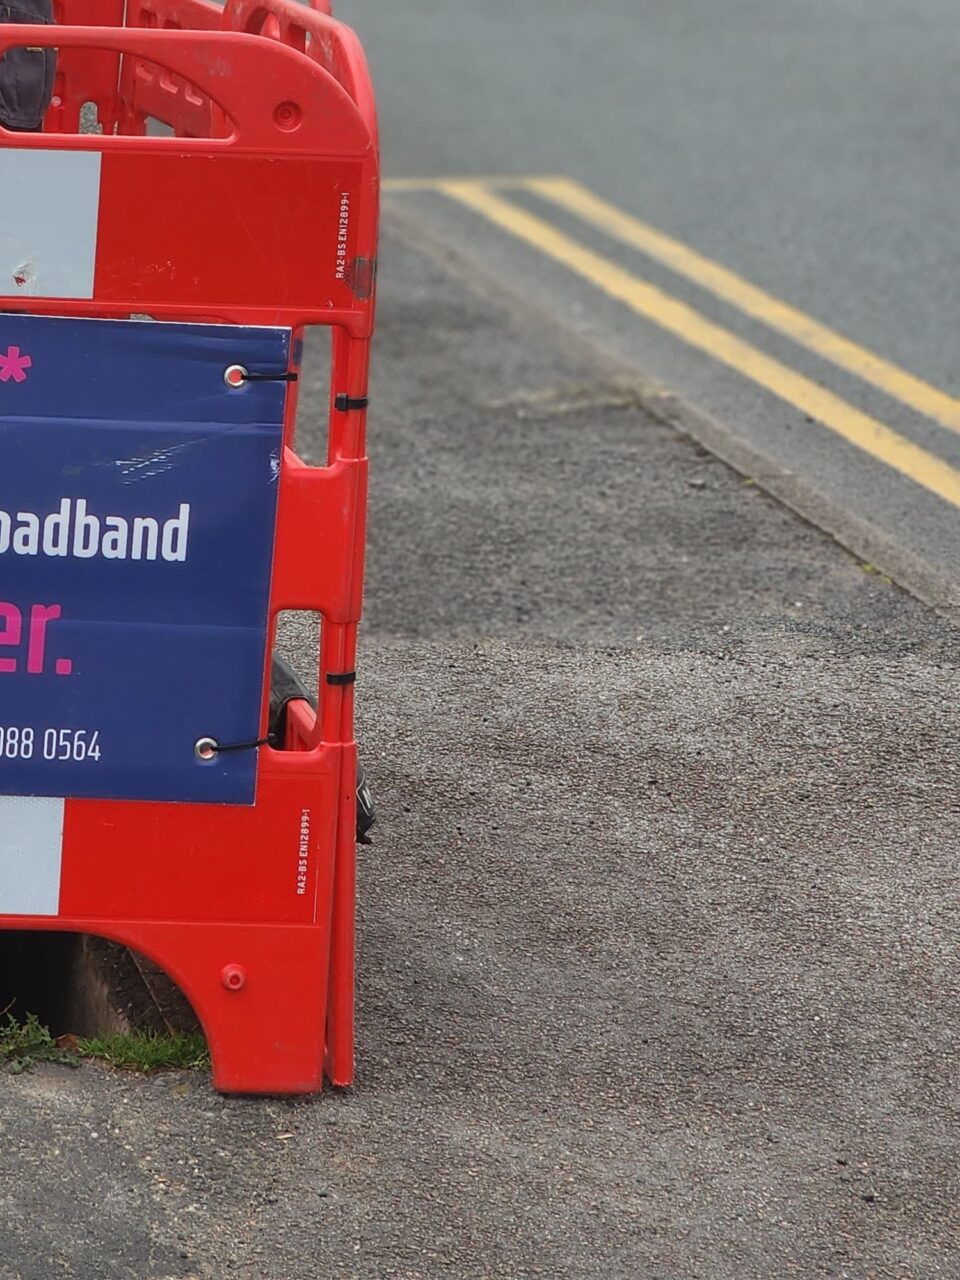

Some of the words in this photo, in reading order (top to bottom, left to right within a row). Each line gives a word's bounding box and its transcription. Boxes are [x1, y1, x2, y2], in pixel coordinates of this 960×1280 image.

[338, 192, 351, 242] EN12899-1
[43, 728, 101, 761] 0564
[299, 808, 311, 858] EN12899-1
